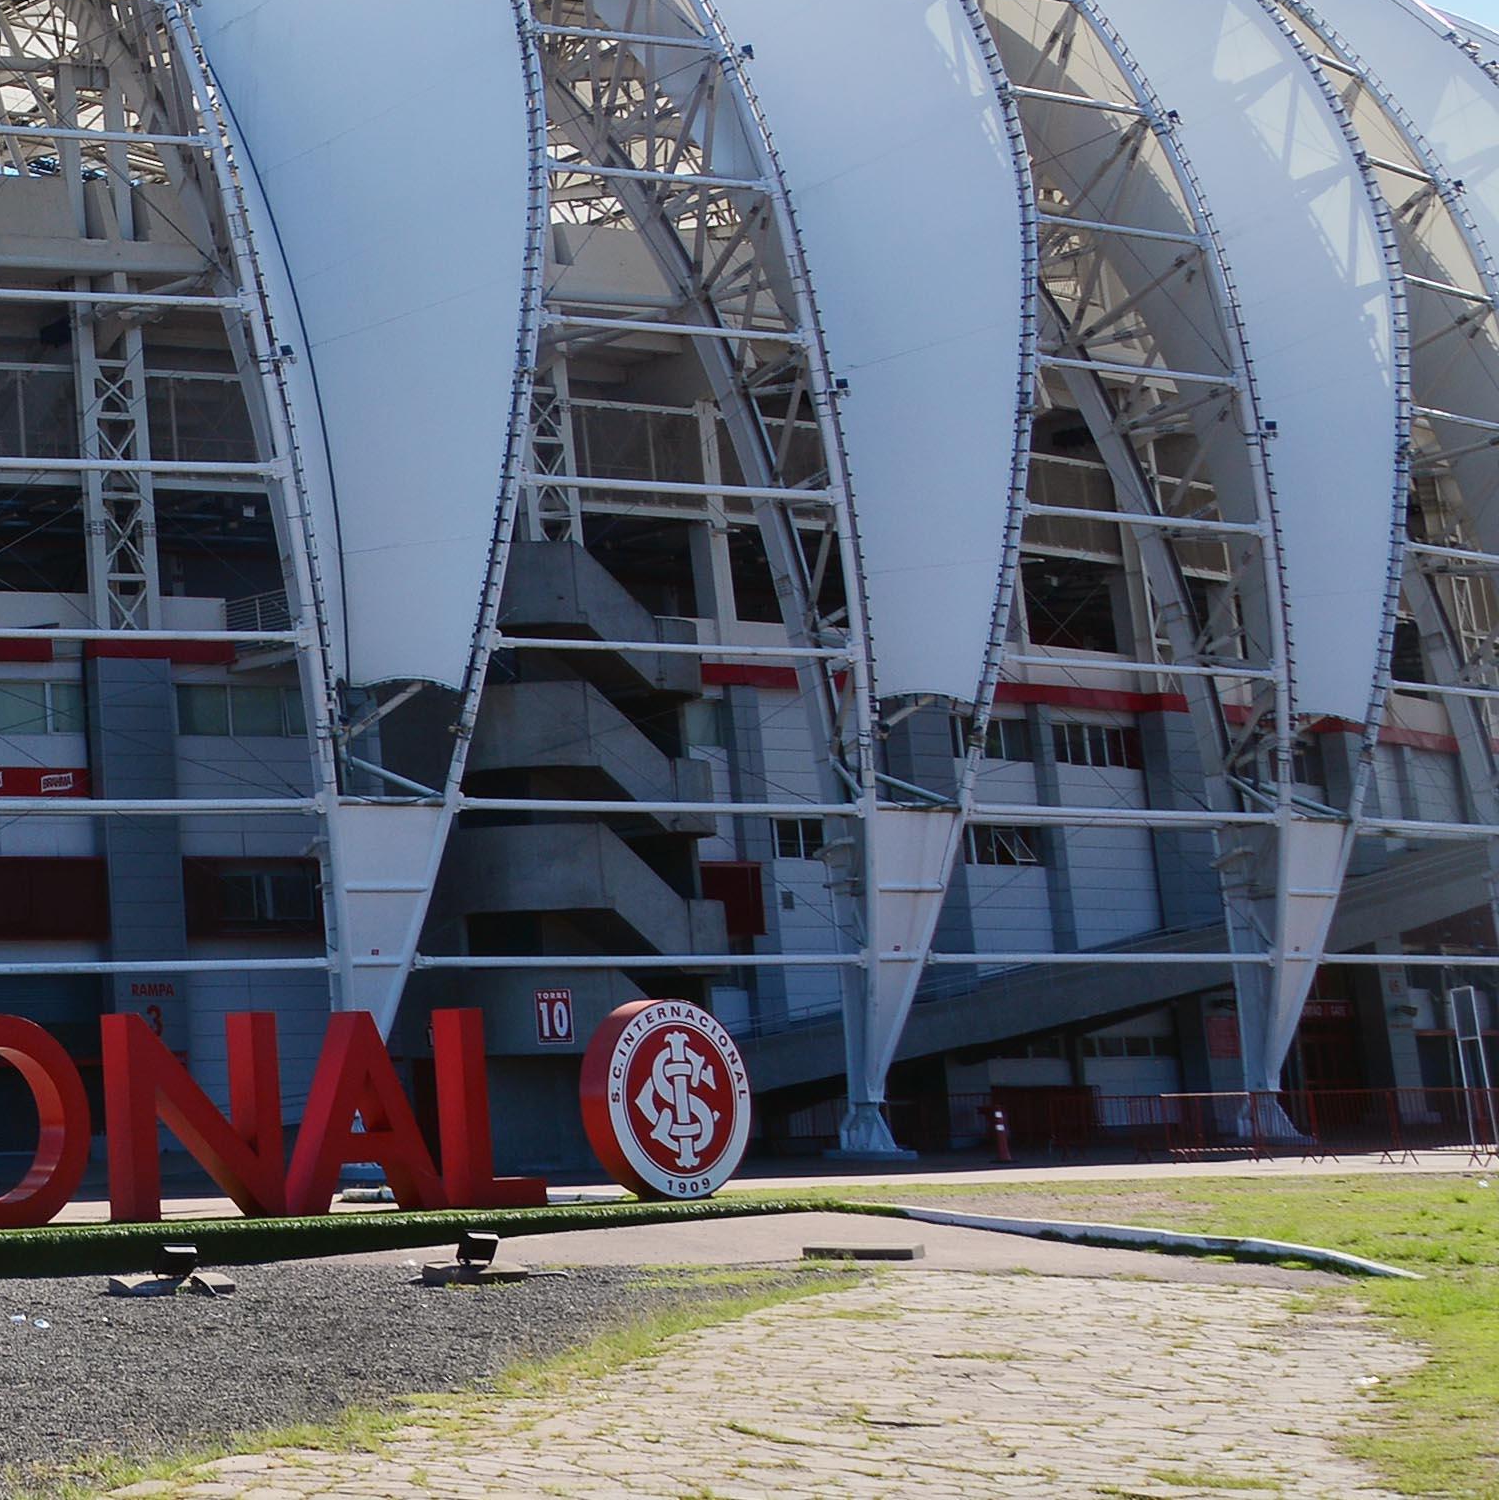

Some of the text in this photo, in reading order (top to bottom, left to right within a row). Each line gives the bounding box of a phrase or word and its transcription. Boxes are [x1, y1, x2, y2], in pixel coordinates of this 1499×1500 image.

[41, 774, 73, 790] BRAHMA
[131, 983, 175, 996] RAMPA
[537, 991, 567, 999] TORRE
[147, 1004, 163, 1037] 3
[539, 1001, 568, 1037] 10
[619, 1006, 749, 1100] INTERNACIONAL
[667, 1178, 711, 1194] 1909
